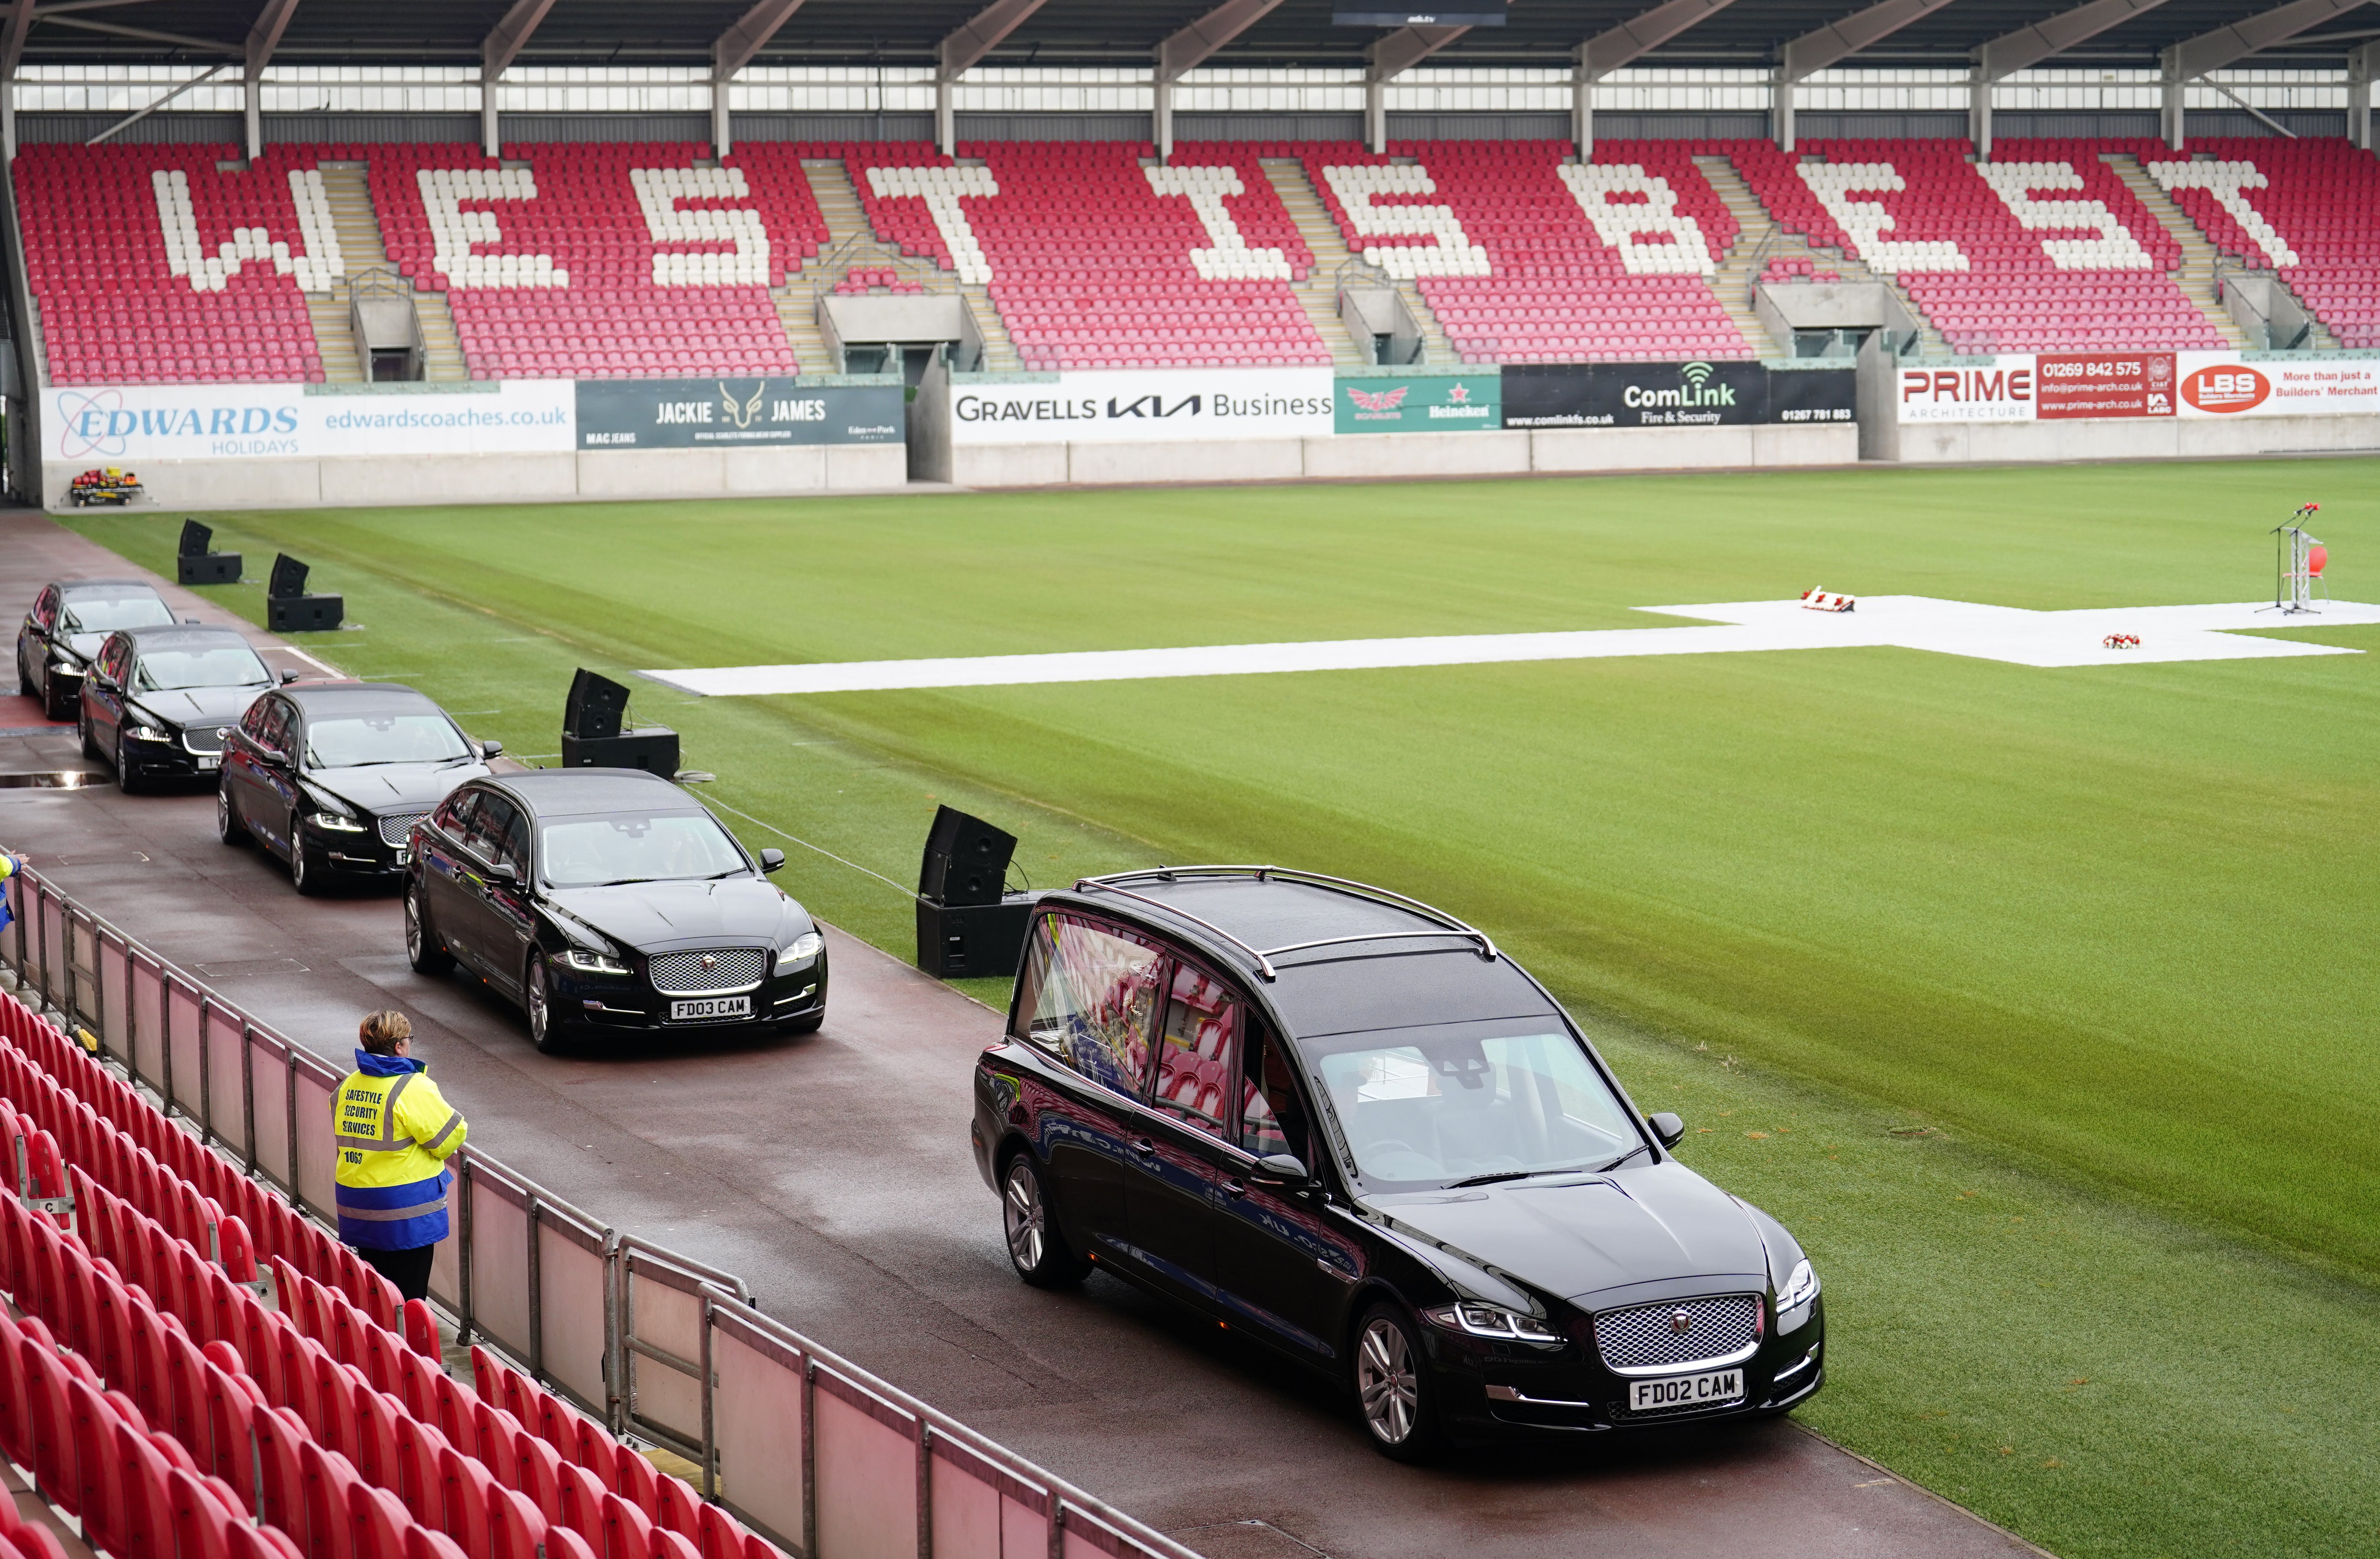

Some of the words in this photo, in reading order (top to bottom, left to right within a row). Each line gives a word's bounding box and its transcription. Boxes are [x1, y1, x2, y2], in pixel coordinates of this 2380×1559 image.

[152, 165, 994, 291] WEST
[1143, 165, 1492, 282] IS
[1557, 161, 2299, 276] BEST
[2043, 363, 2083, 378] 01269
[2086, 362, 2113, 376] 842
[2116, 362, 2141, 376] 575
[2283, 371, 2310, 380] More
[2314, 371, 2337, 380] than
[2341, 370, 2360, 382] just
[1904, 370, 2030, 402] PRIME
[2041, 382, 2143, 394] info@prime-arch.co.uk
[2198, 373, 2256, 393] LBS
[2328, 386, 2377, 395] Merchant
[1625, 382, 1735, 407] ComLink
[656, 402, 713, 424] JACKIE
[771, 399, 826, 421] JAMES
[1214, 393, 1332, 416] Business
[1429, 405, 1489, 419] Heineken
[1909, 407, 2026, 418] ARCHITECTURE
[2041, 399, 2143, 411] www.prime-arch.co.uk
[79, 406, 298, 437] EDWARDS
[1641, 411, 1663, 424] Fire
[1665, 410, 1676, 423] &
[1678, 410, 1722, 425] Security
[586, 433, 610, 444] MAC
[610, 432, 636, 444] JEANS
[213, 439, 299, 455] HOLIDAYS
[677, 1001, 713, 1016] FD03
[718, 999, 745, 1014] CAM
[345, 1089, 382, 1105] SAFESTYLE
[344, 1105, 377, 1120] SECURITY
[343, 1120, 375, 1136] SERVICES
[344, 1151, 363, 1165] 1063
[45, 1202, 53, 1212] C
[1638, 1380, 1692, 1405] FD02
[1698, 1373, 1735, 1398] CAM
